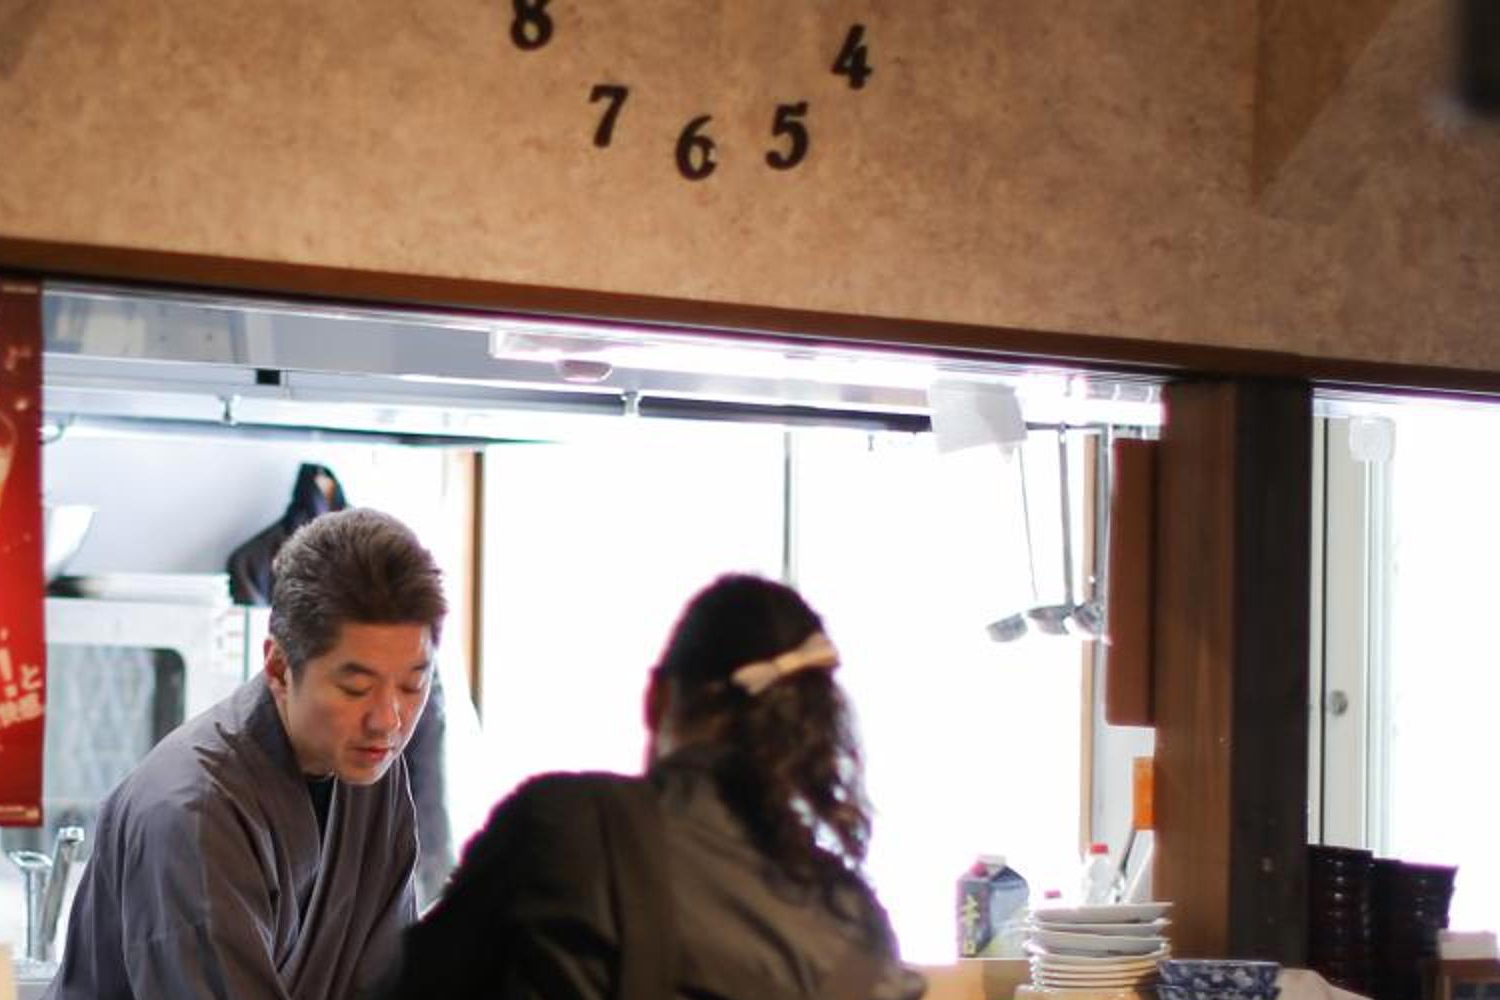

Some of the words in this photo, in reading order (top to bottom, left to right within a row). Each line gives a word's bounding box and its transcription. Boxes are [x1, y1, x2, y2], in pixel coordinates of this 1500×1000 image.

[510, 0, 554, 51] 8
[831, 24, 873, 90] 4
[590, 84, 630, 148] 7
[675, 115, 717, 181] 6
[765, 101, 809, 170] 5
